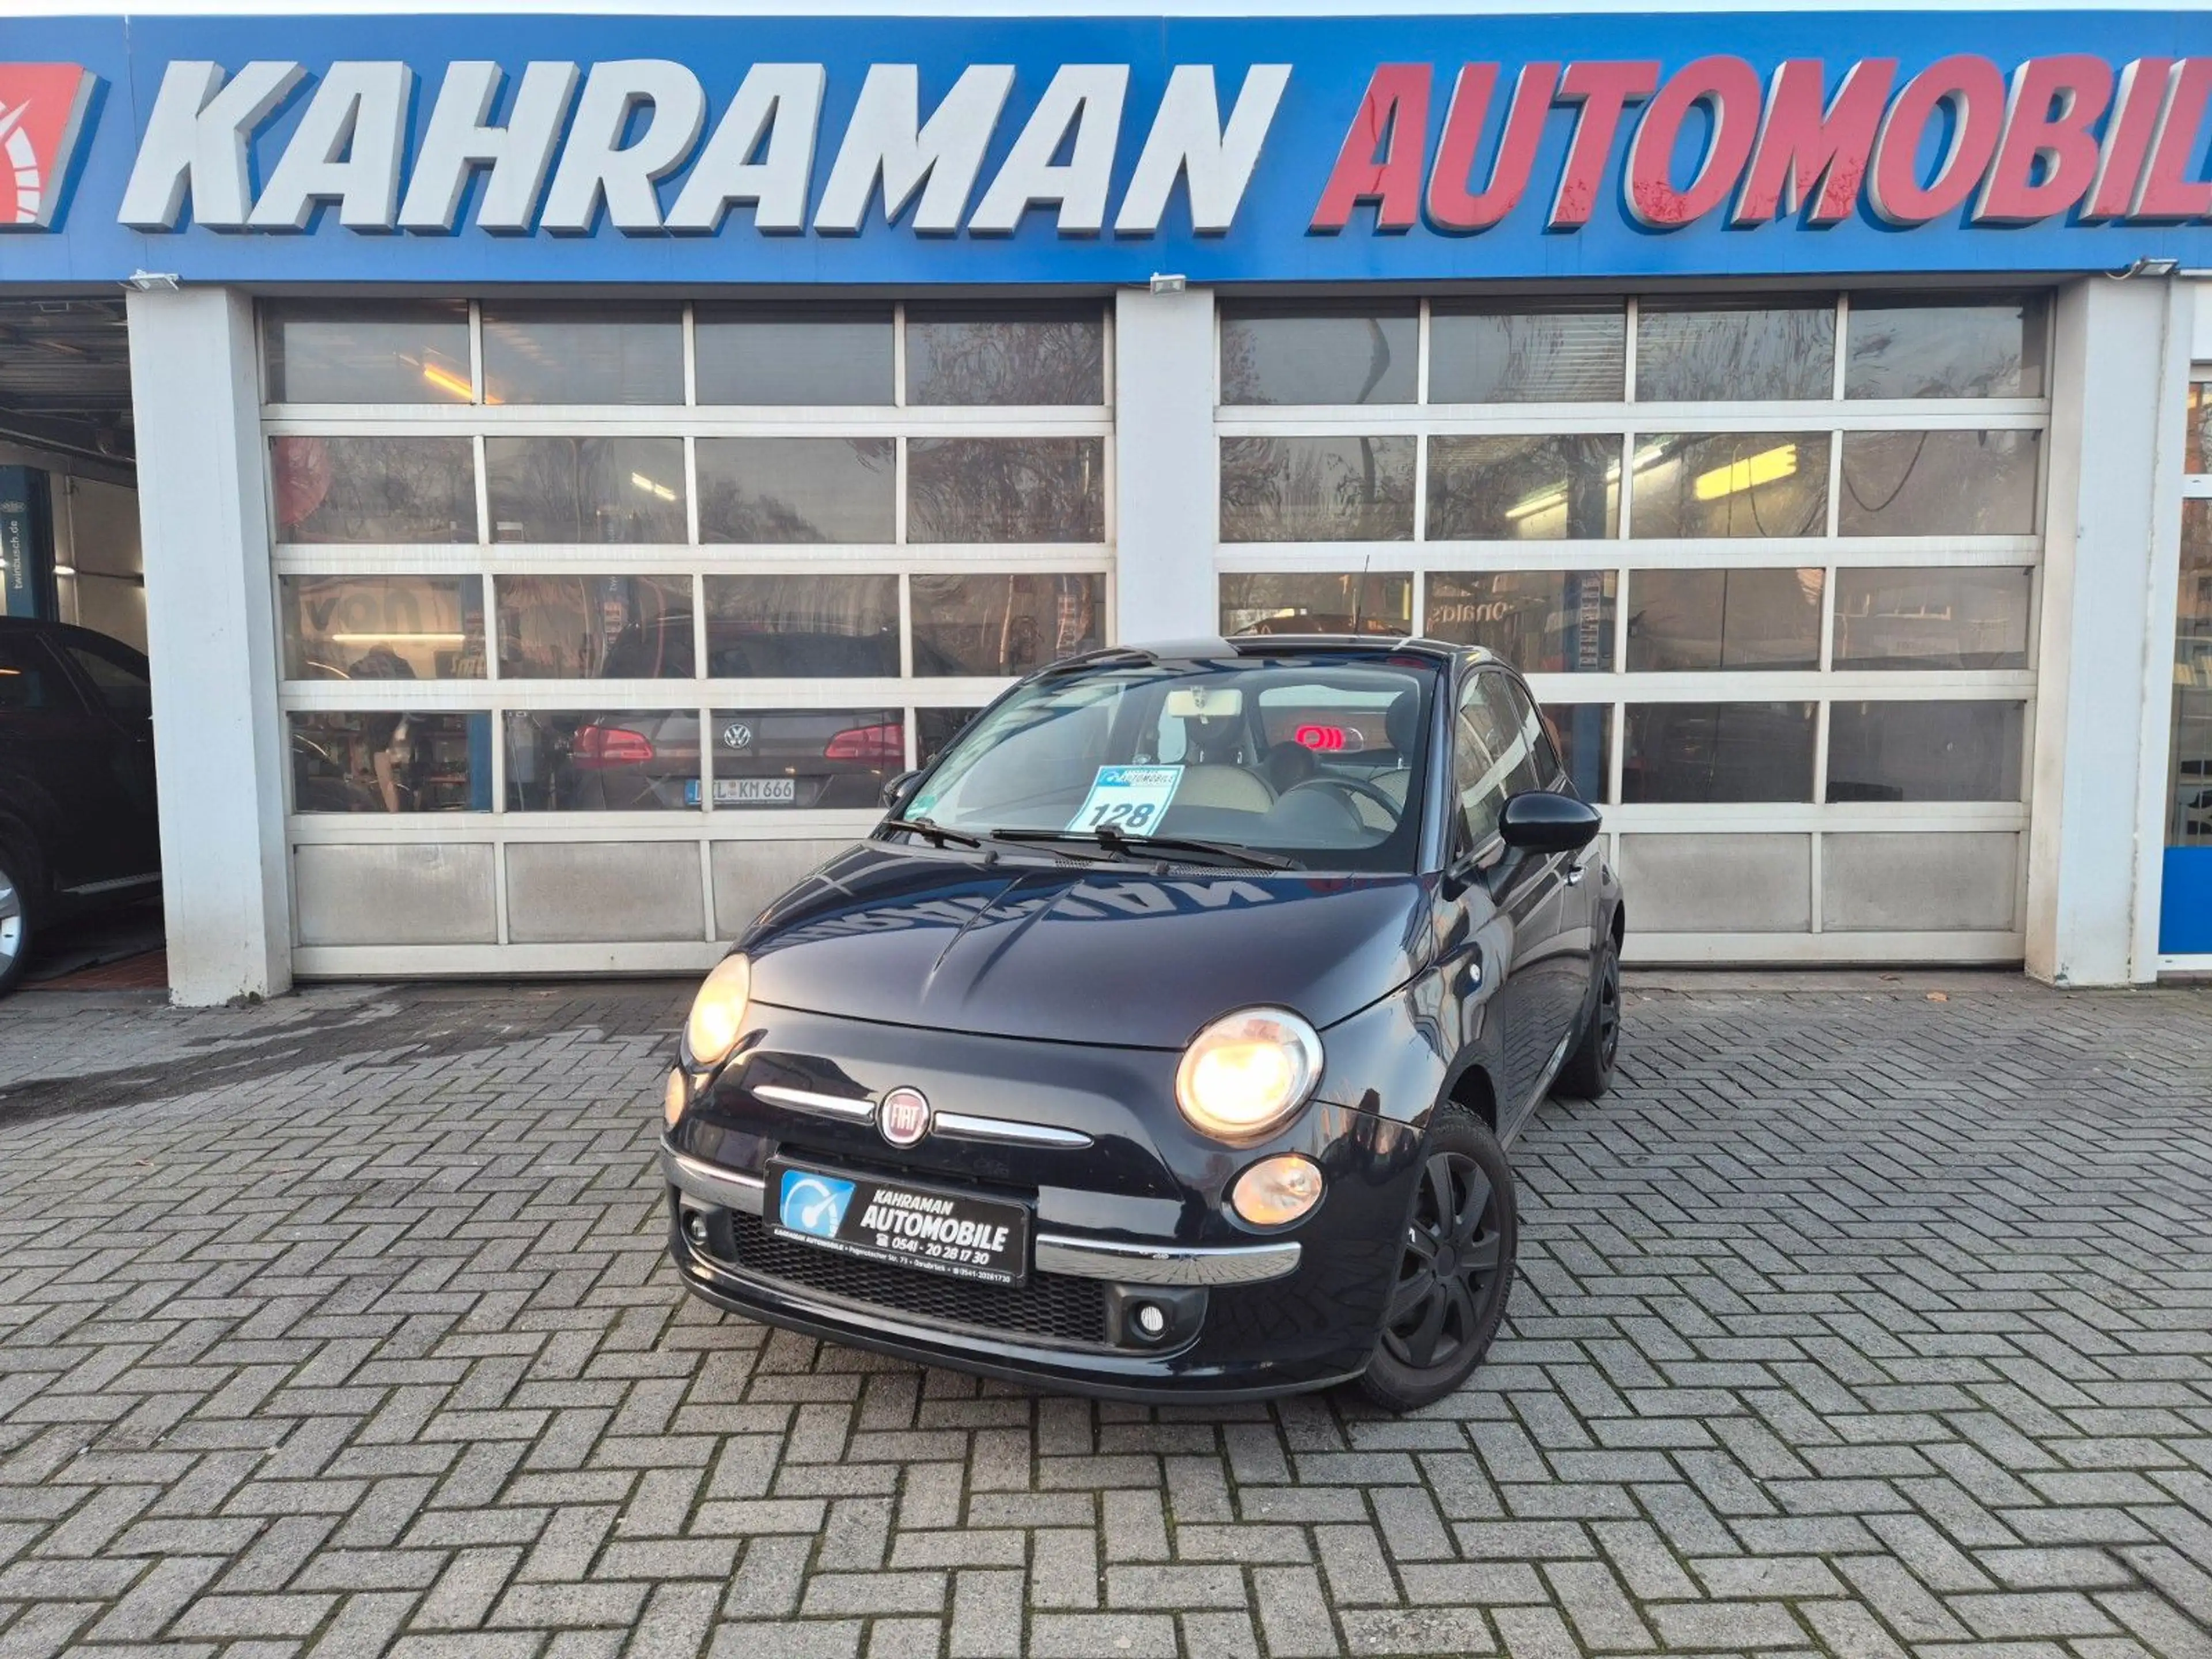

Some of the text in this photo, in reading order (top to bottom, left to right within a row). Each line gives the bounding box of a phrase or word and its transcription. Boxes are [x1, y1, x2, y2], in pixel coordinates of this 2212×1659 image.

[117, 54, 2212, 235] KAHRAMAN AUTOMOBIL
[10, 521, 23, 589] twinbusch.de
[763, 782, 792, 797] 666
[1089, 804, 1155, 827] 128
[890, 1104, 921, 1132] FIAT
[872, 1189, 954, 1216] KAHRAMAN
[859, 1205, 1009, 1252] AUTOMOBILE
[892, 1236, 919, 1253] 0541
[925, 1243, 941, 1257] 20
[942, 1247, 958, 1260] 28
[960, 1249, 971, 1262] 17
[972, 1252, 990, 1265] 30
